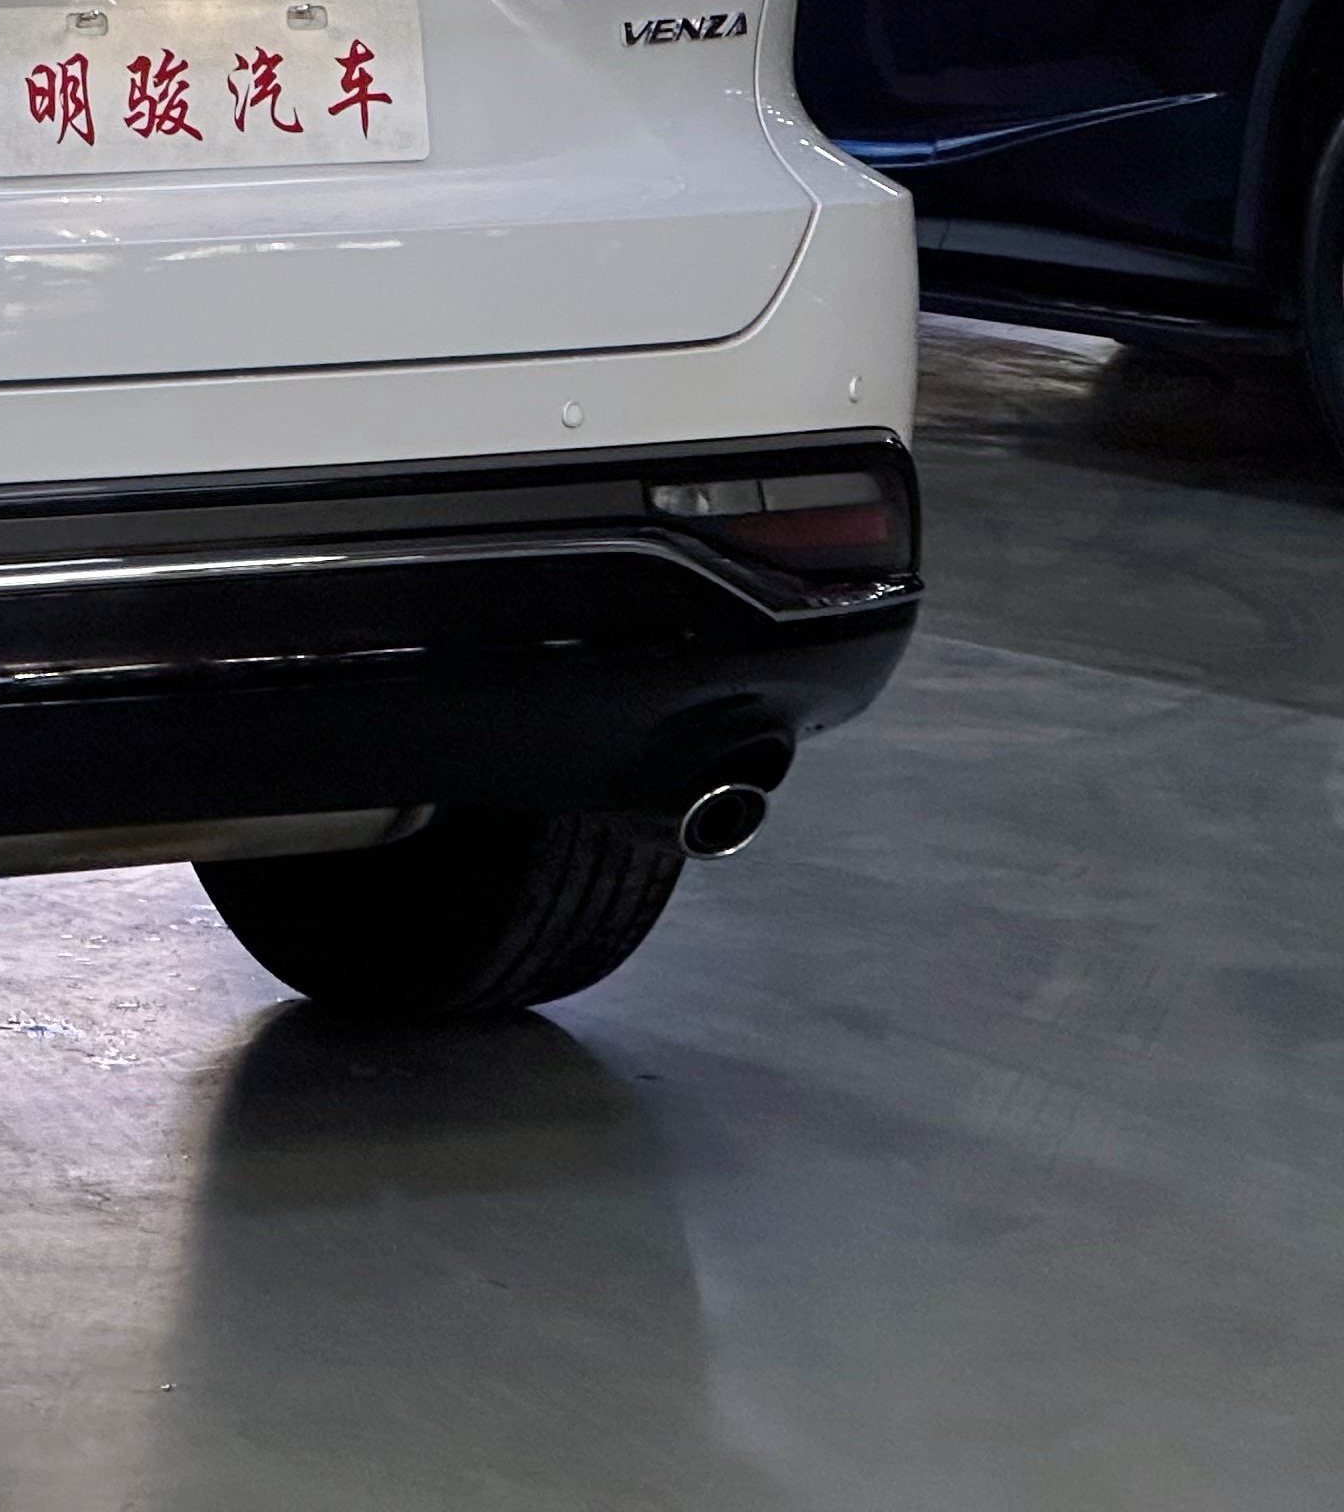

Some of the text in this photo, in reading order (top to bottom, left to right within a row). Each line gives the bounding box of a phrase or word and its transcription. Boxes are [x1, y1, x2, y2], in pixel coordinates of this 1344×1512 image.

[622, 10, 748, 46] VENZA
[25, 39, 393, 147] 明骏汽车
